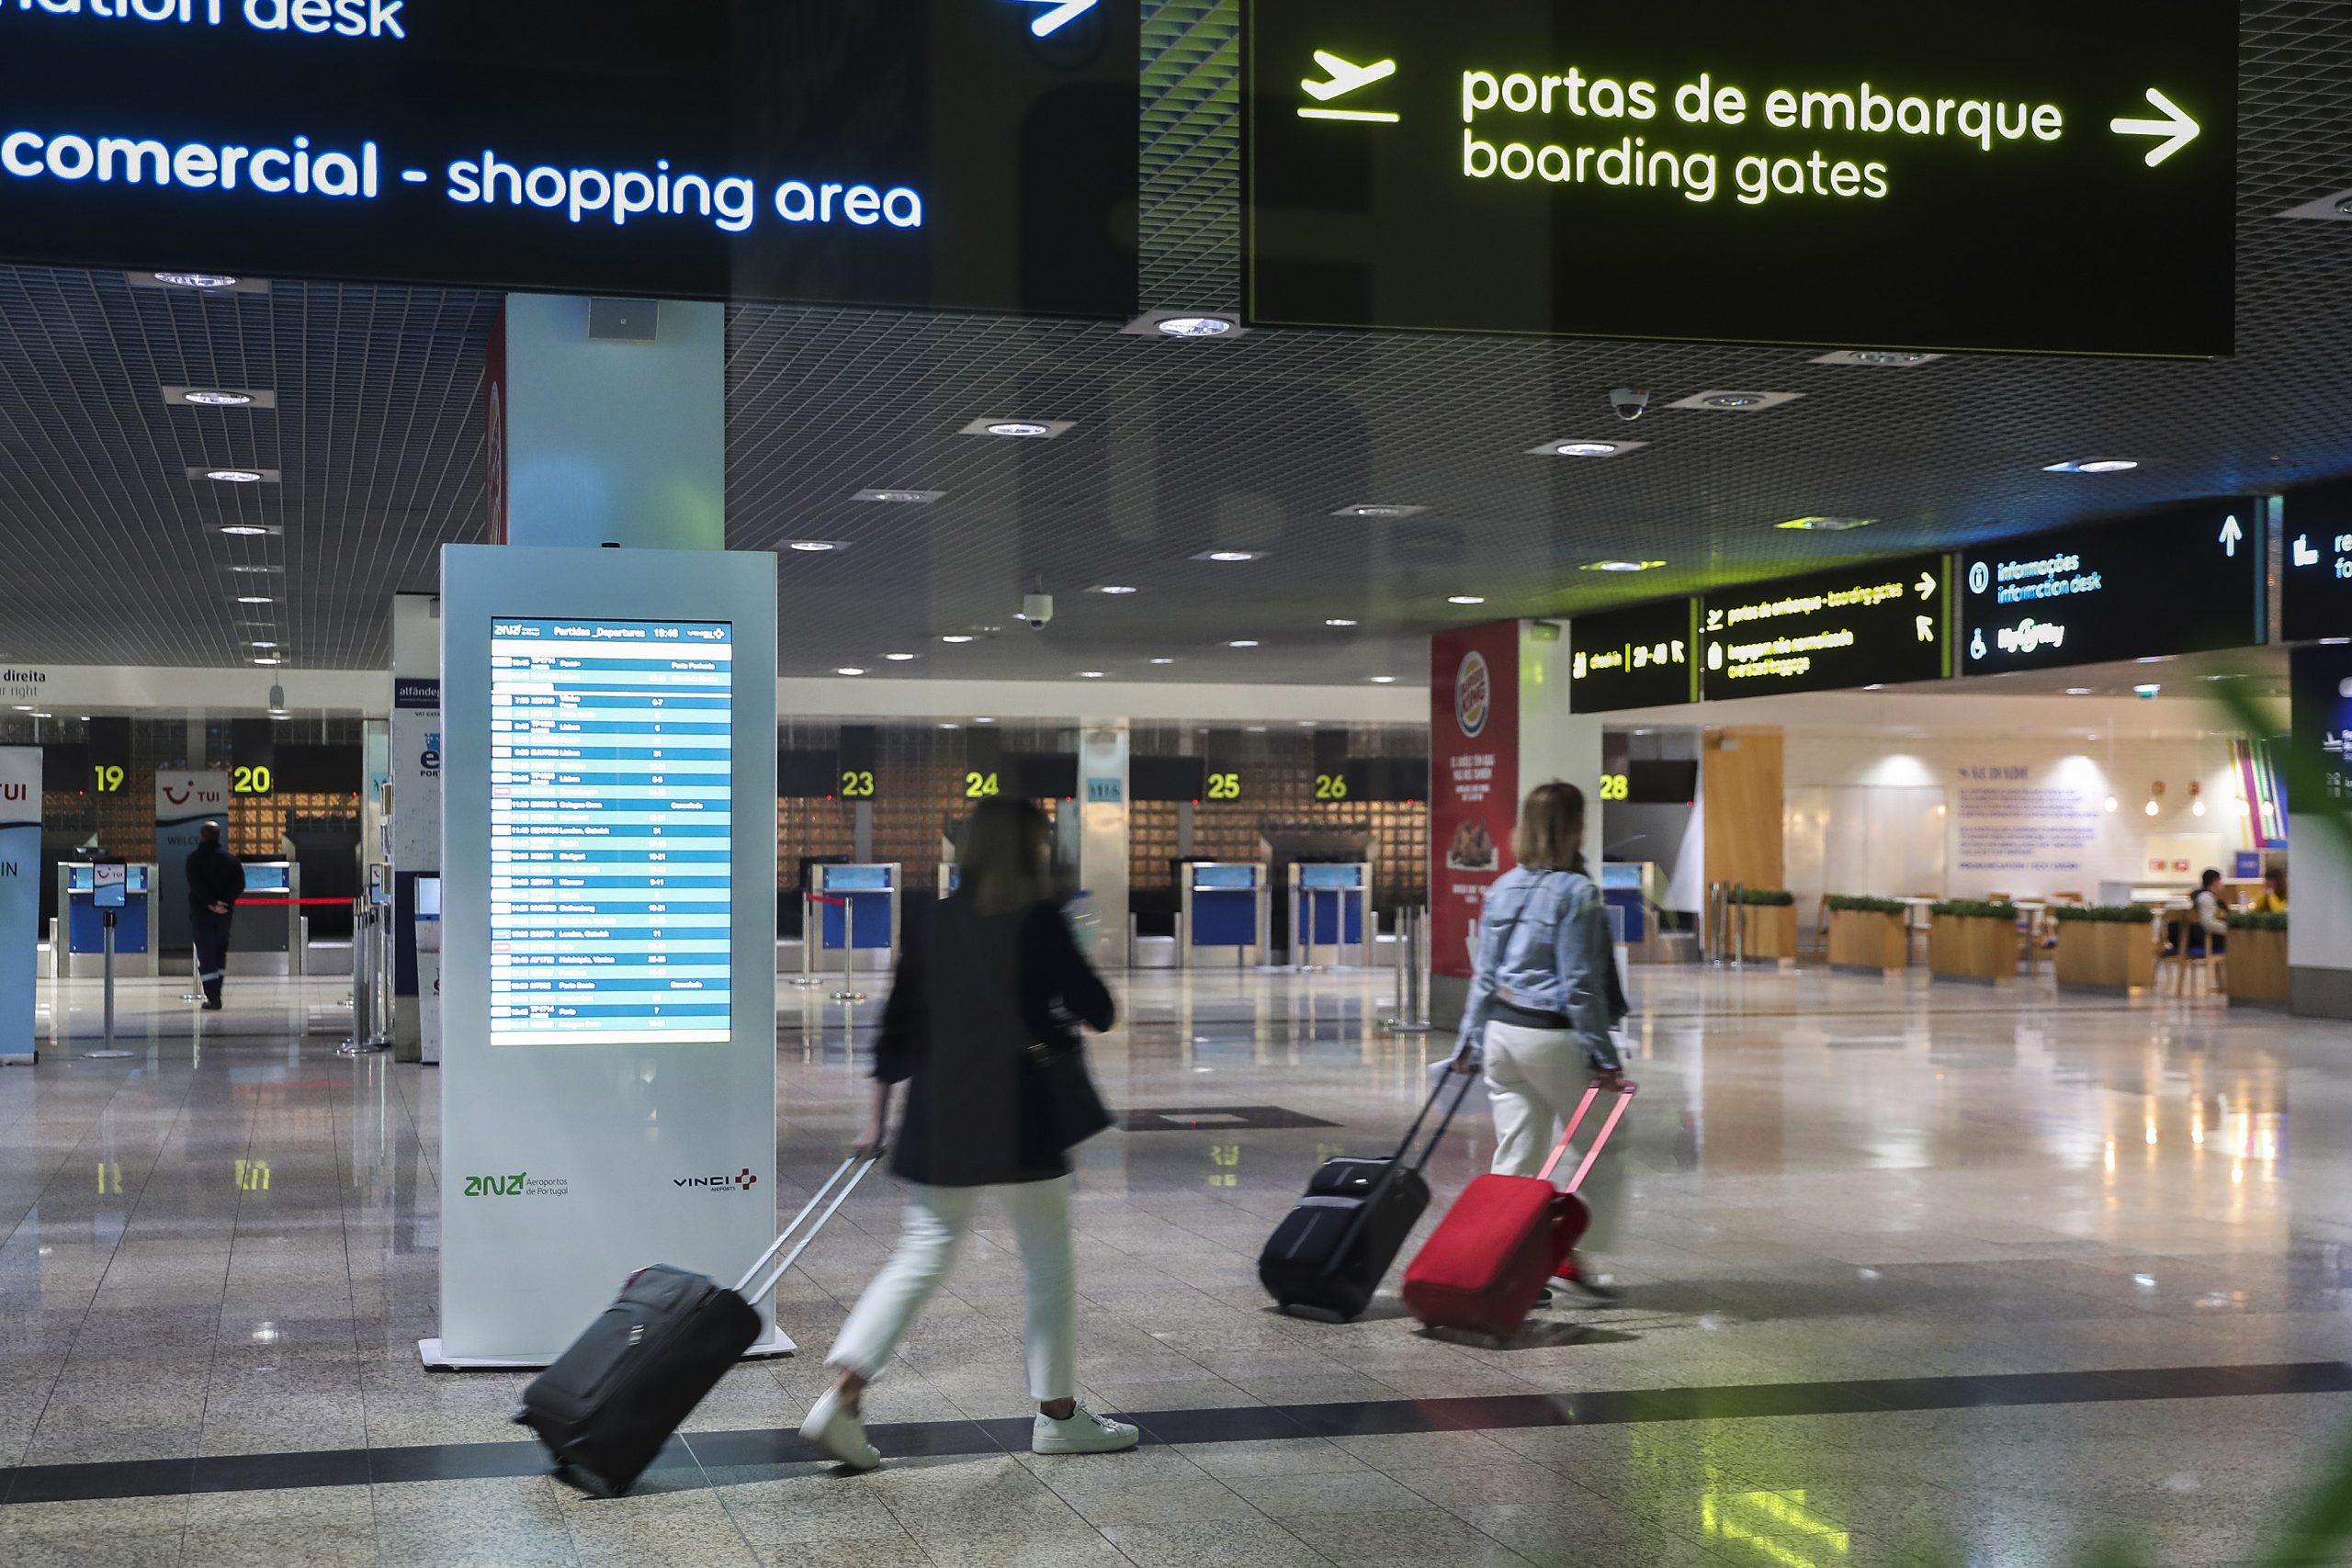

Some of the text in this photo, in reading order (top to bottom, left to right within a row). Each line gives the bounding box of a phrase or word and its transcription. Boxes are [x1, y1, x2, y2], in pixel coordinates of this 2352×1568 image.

[1463, 67, 2063, 152] portas de embarque
[1464, 128, 1887, 205] boarding gates
[1, 131, 377, 197] comercial
[447, 150, 753, 231] shopping
[775, 181, 922, 227] area
[4, 670, 46, 682] direita
[11, 685, 37, 698] right
[95, 765, 124, 793] 19
[233, 765, 270, 794] 20
[842, 772, 875, 796] 23
[966, 772, 1000, 798] 24
[1208, 773, 1240, 799] 25
[1315, 774, 1347, 799] 26
[1600, 774, 1629, 800] 28
[198, 792, 220, 802] TUI
[2, 862, 17, 876] IN
[526, 1178, 568, 1186] Aeroportos
[537, 1187, 568, 1197] Portugal
[673, 1177, 729, 1188] VINCI
